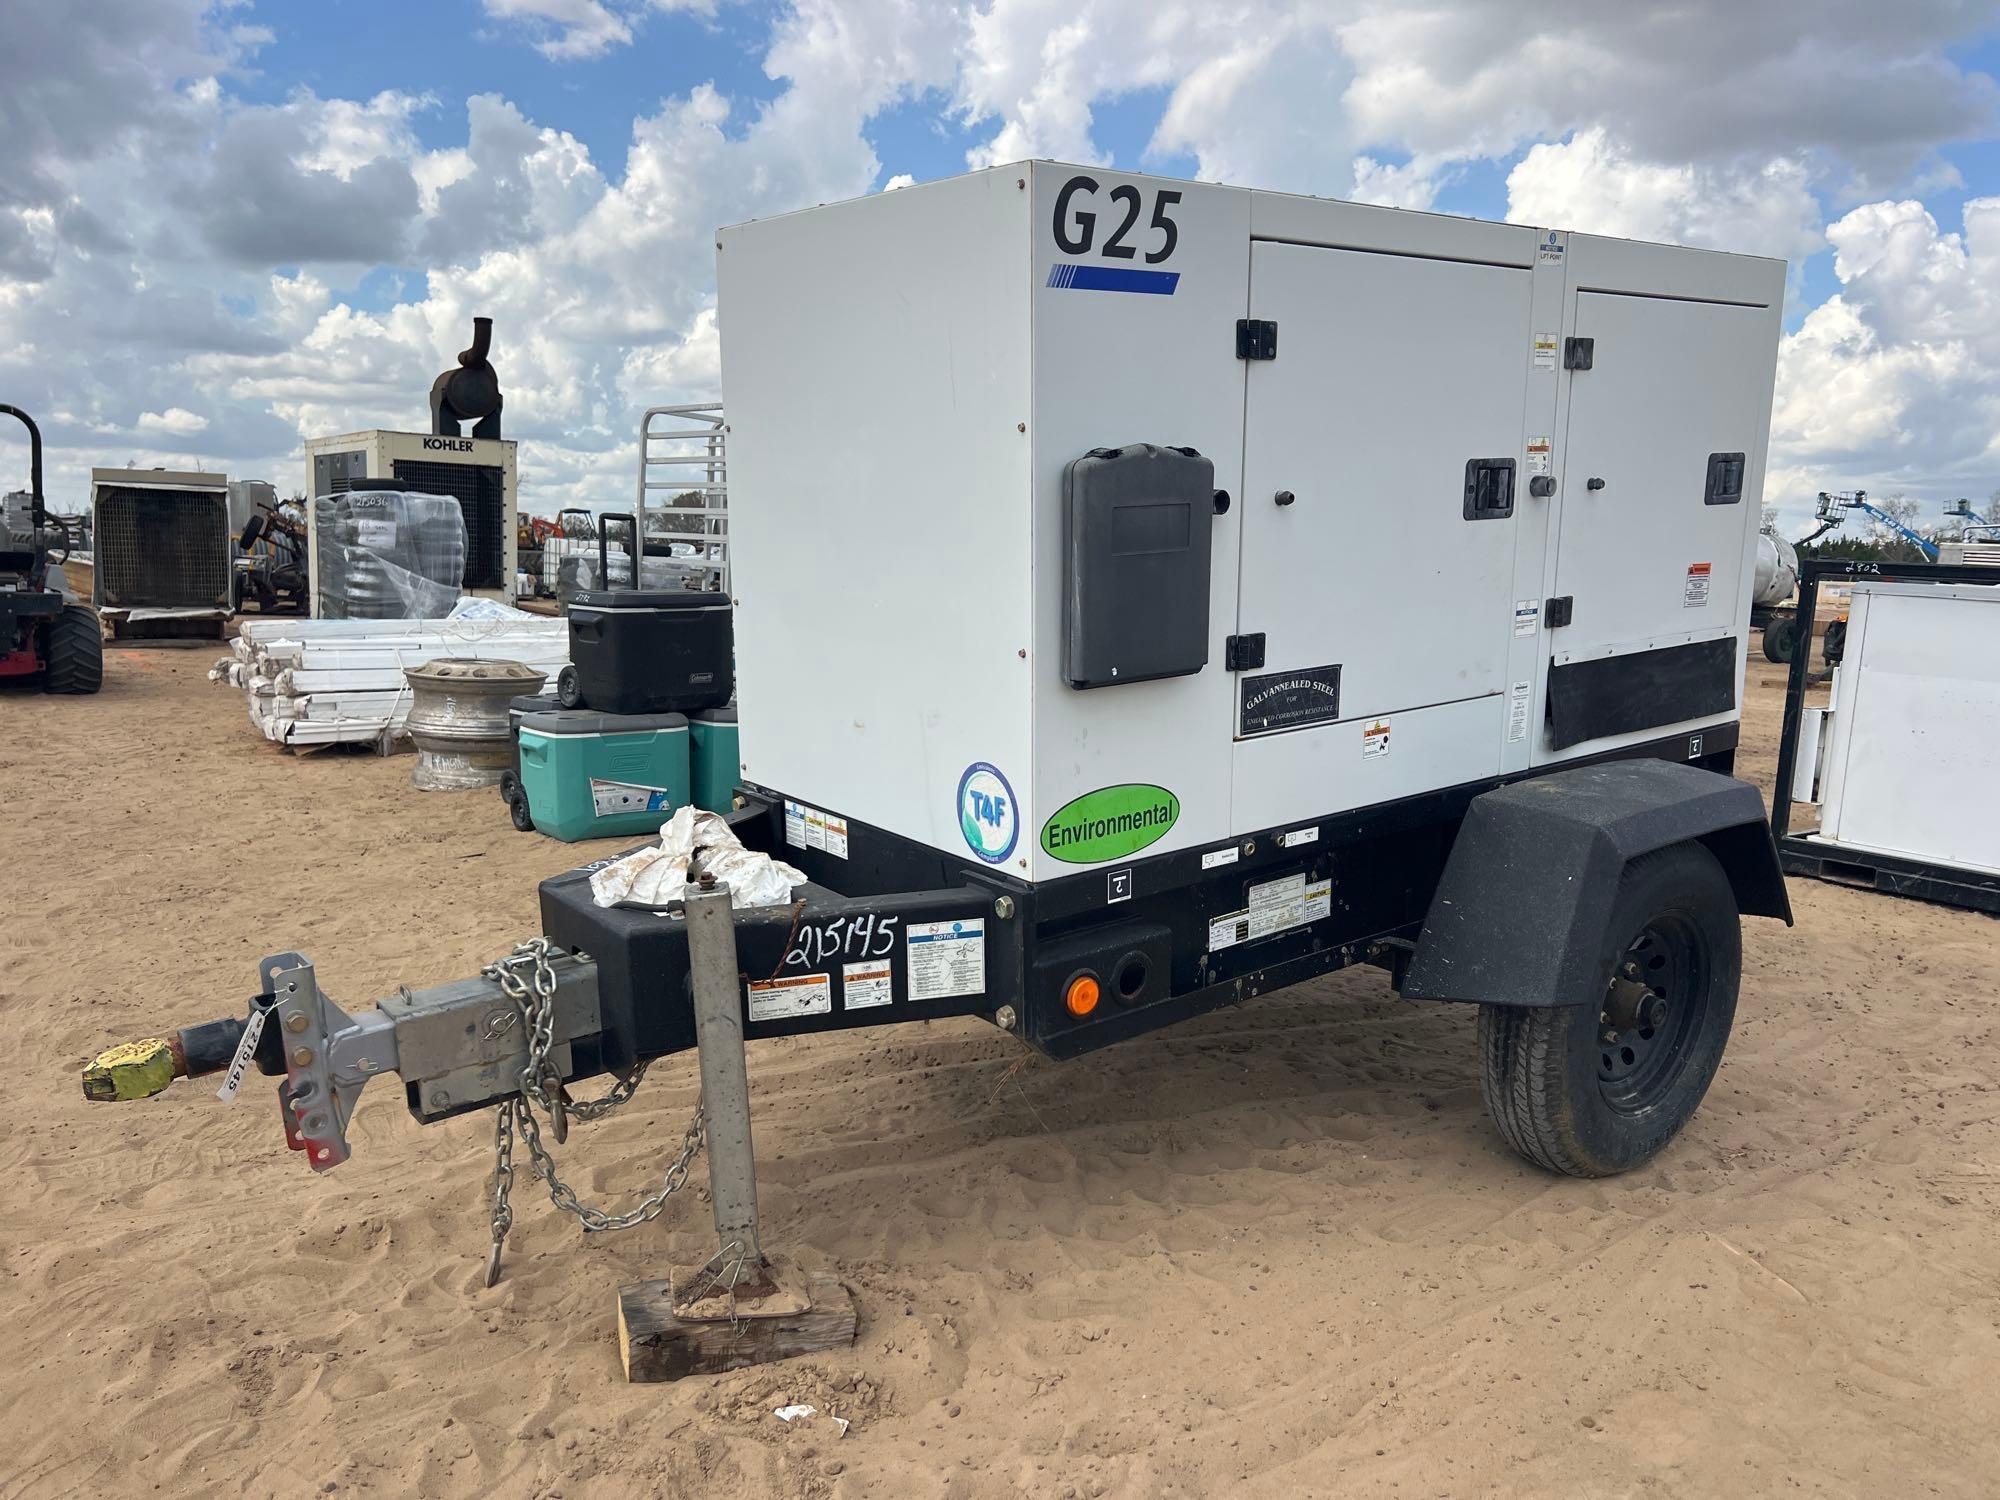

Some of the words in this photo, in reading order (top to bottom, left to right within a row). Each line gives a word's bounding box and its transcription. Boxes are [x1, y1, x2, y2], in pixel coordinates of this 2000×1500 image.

[1052, 175, 1182, 264] G25
[423, 438, 474, 452] KOHLER
[1246, 679, 1311, 710] GALVANNEALED
[1312, 681, 1335, 697] STEEL
[1304, 704, 1334, 716] RESISTANCE
[970, 789, 1006, 828] T4F
[1049, 799, 1173, 849] Environmental
[786, 914, 899, 969] 215145
[933, 933, 958, 942] NOTICE
[777, 978, 809, 988] WARNING
[857, 970, 886, 980] WARNING
[228, 1030, 259, 1092] 215145
